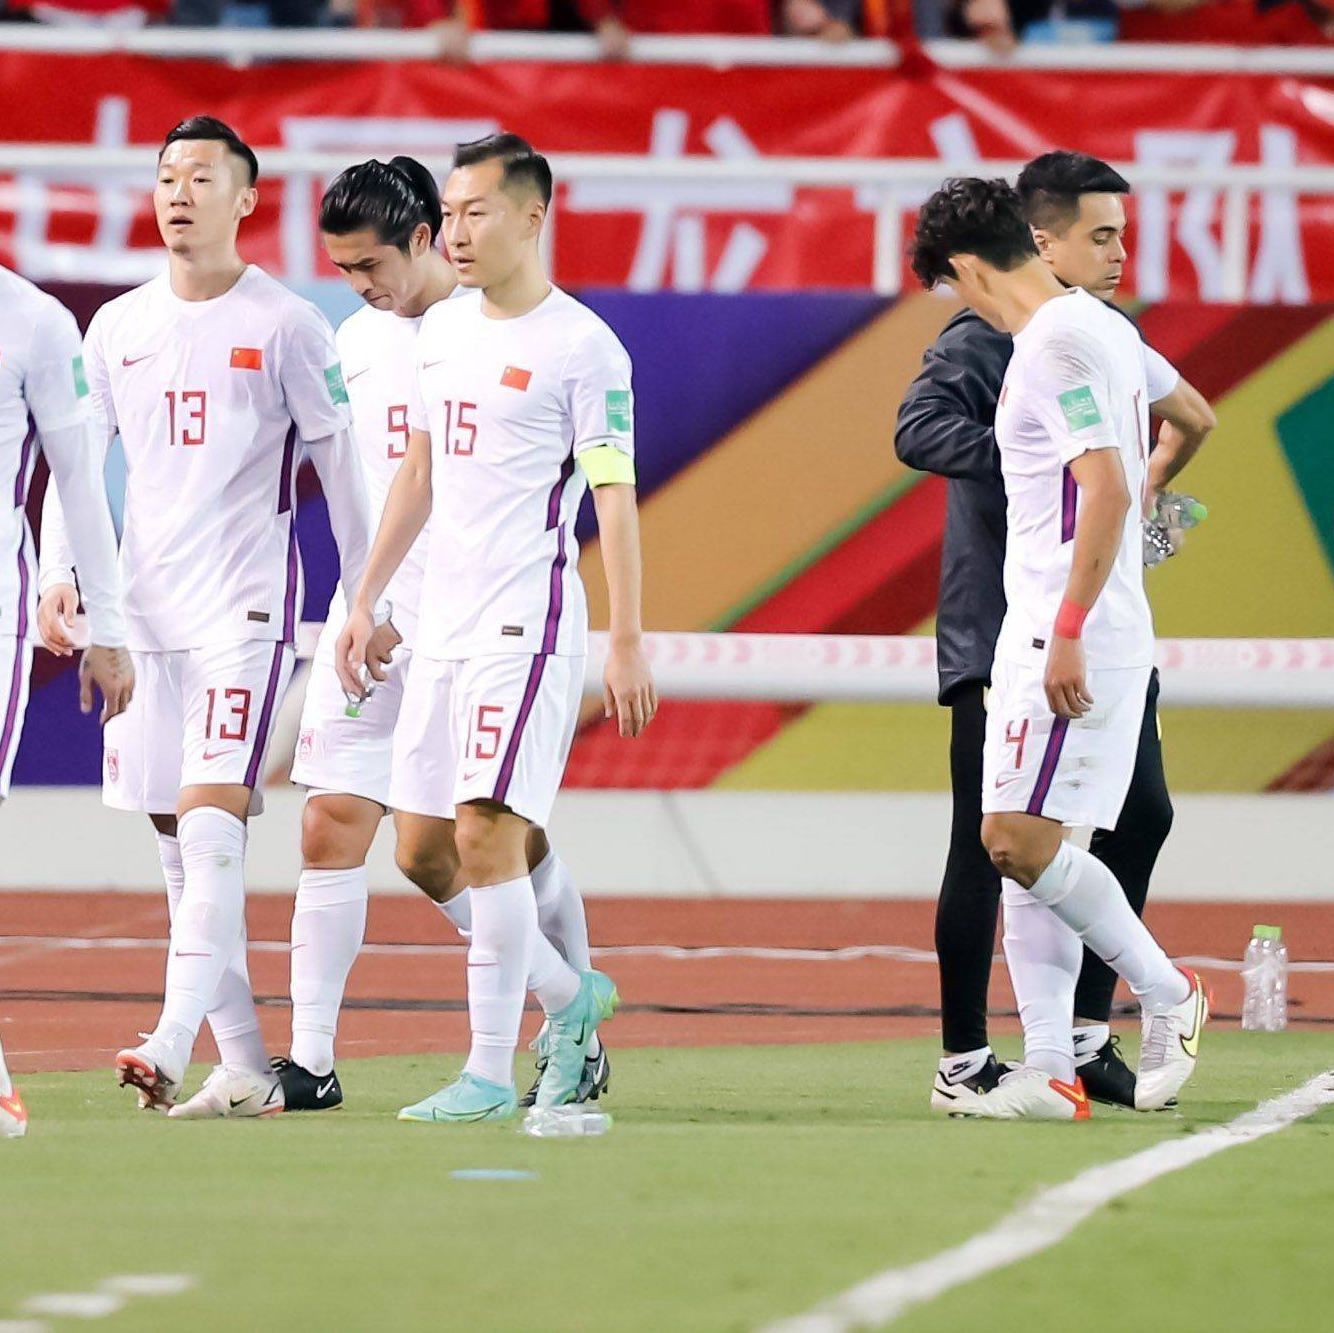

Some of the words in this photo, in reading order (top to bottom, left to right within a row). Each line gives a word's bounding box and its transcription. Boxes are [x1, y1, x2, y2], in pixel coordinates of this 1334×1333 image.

[164, 389, 207, 447] 13
[387, 404, 411, 459] 9
[443, 399, 478, 456] 15
[204, 687, 252, 742] 13
[464, 703, 505, 760] 15
[1005, 717, 1030, 770] 4
